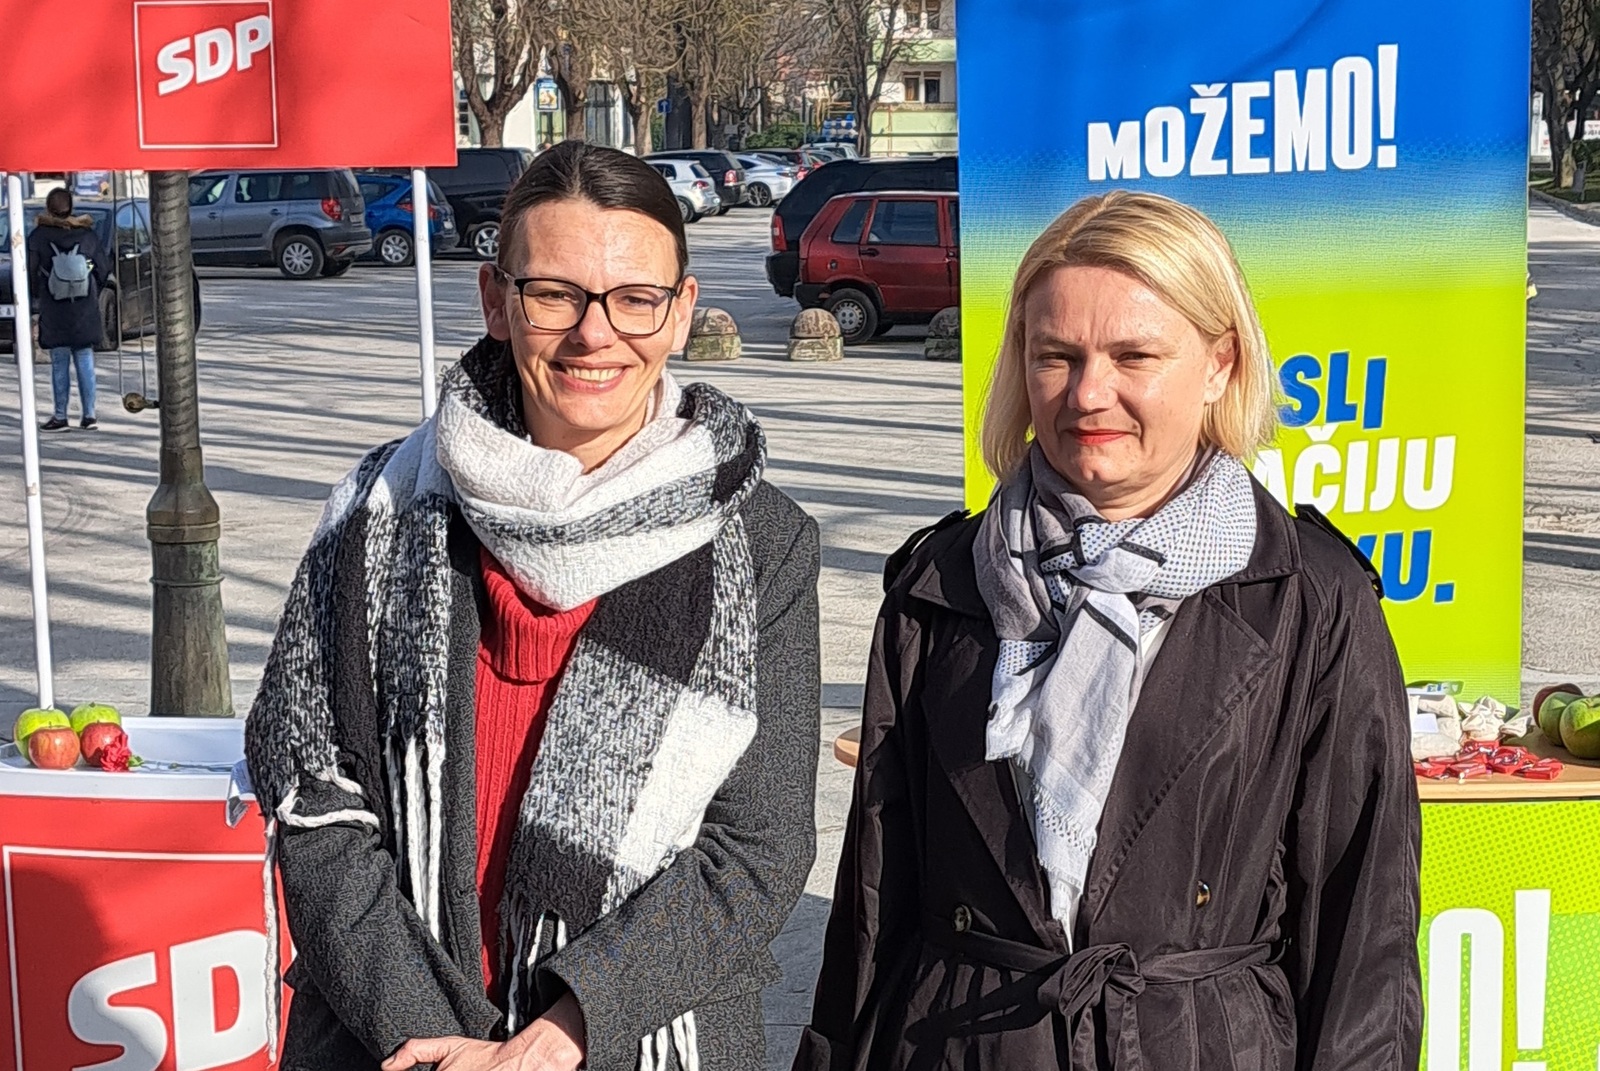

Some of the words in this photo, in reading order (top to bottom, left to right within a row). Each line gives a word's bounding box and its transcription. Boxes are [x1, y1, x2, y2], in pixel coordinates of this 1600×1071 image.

[156, 14, 272, 97] SDP
[1087, 43, 1399, 181] MOŽEMO!
[1277, 350, 1388, 430] SLI
[1252, 423, 1456, 514] AČIJU
[68, 929, 297, 1071] SD
[1428, 887, 1551, 1071] O!
